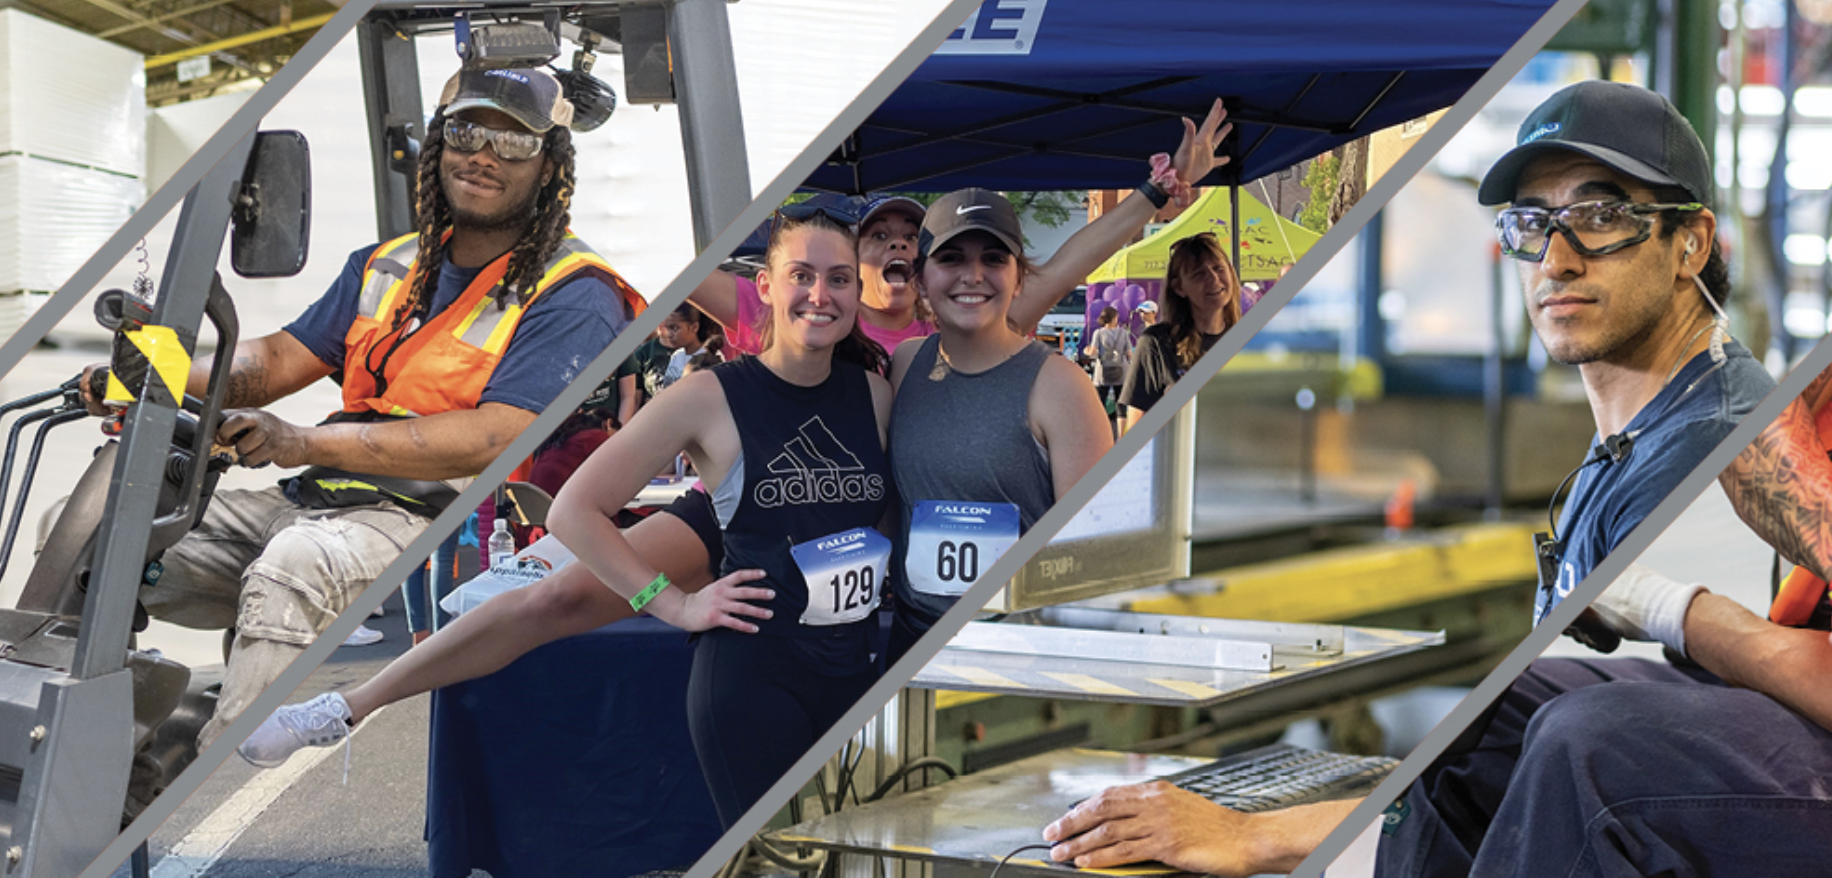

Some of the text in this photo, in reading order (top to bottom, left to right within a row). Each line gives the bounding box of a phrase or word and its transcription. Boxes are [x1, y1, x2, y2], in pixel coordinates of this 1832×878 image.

[754, 468, 885, 508] adidas
[935, 505, 992, 515] FALCON
[817, 531, 867, 551] FALCON
[937, 540, 978, 583] 60
[830, 565, 874, 613] 129
